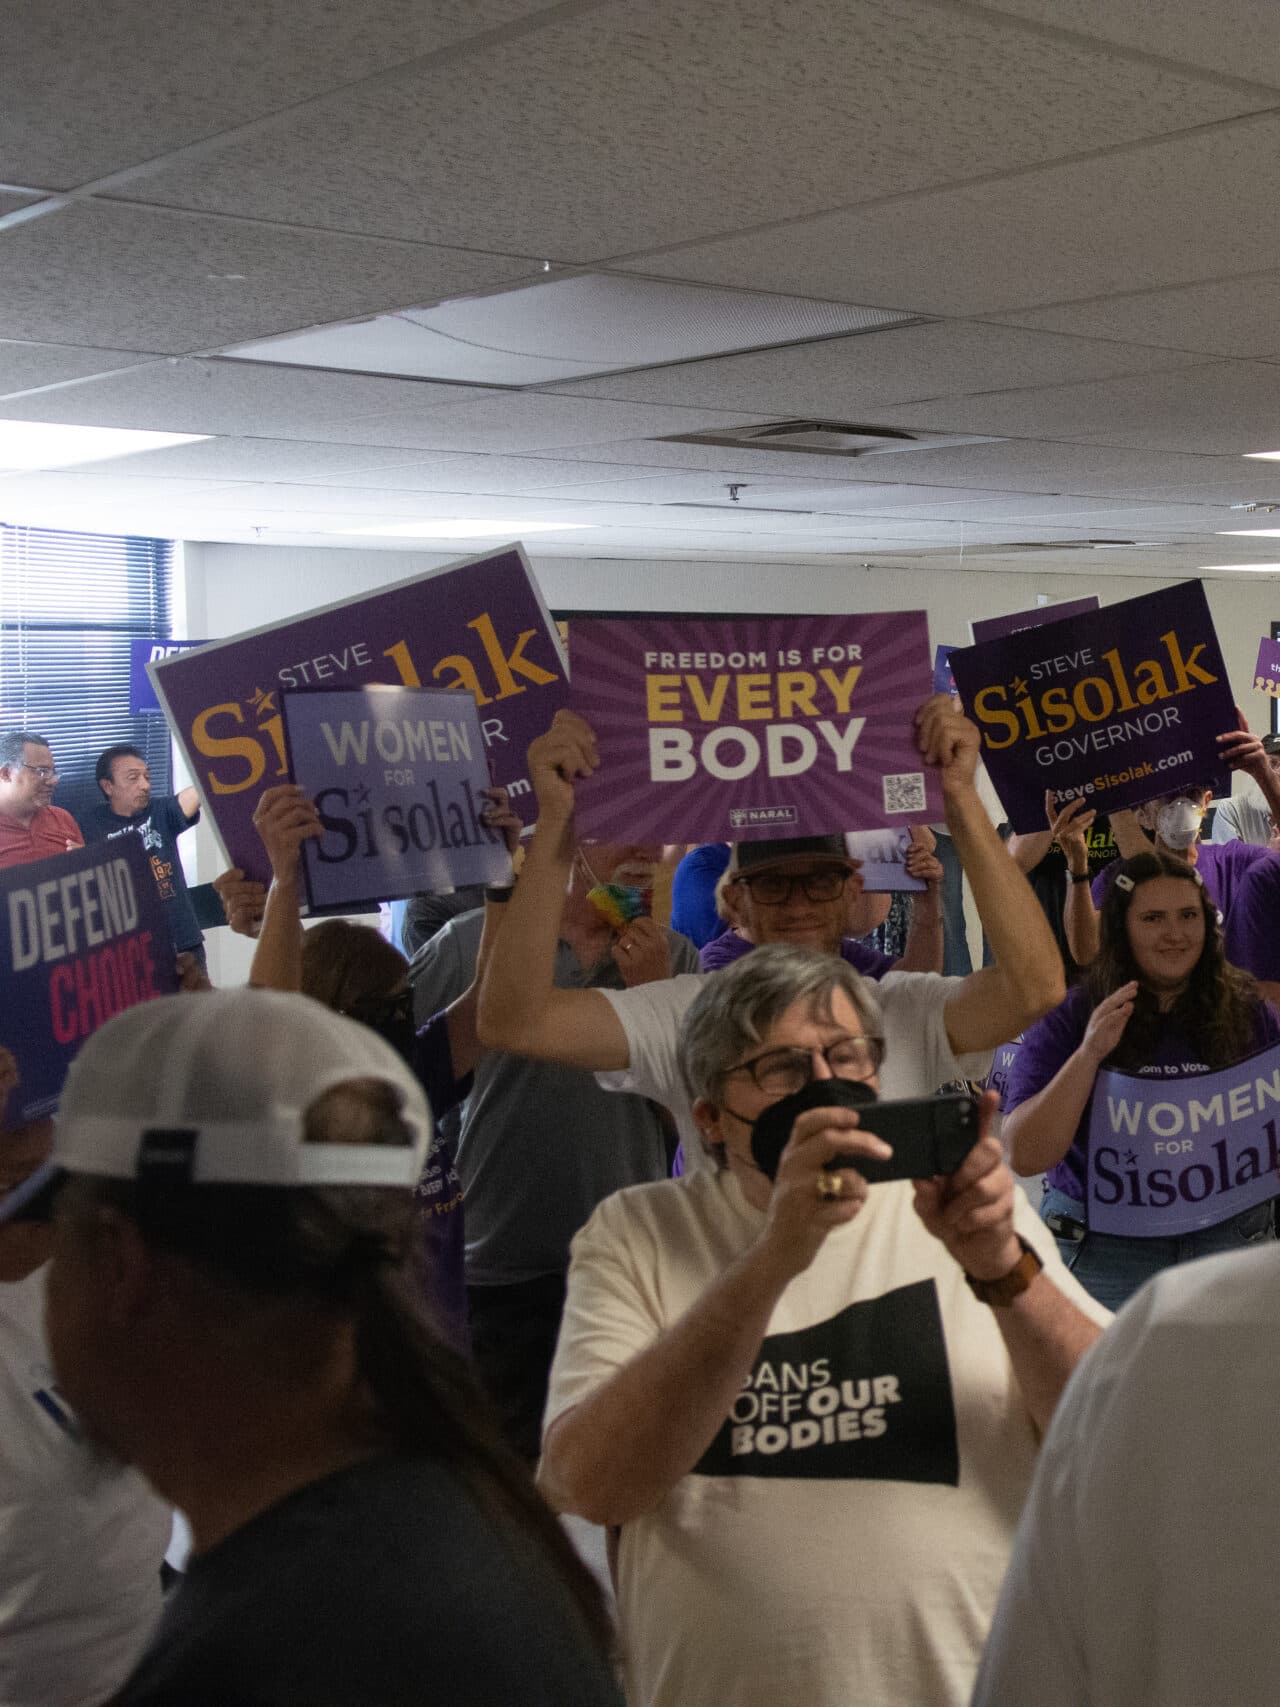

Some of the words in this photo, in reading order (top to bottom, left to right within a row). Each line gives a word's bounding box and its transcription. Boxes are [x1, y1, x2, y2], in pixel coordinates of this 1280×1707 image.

[279, 643, 373, 688] STEVE
[644, 651, 768, 670] FREEDOM
[778, 649, 802, 667] IS
[813, 644, 864, 665] FOR
[1030, 648, 1095, 681] STEVE
[192, 612, 559, 795] Silak
[645, 665, 864, 722] EVERY
[974, 630, 1218, 750] Sisolak
[320, 720, 473, 766] WOMEN
[648, 717, 867, 782] BODY
[1035, 707, 1182, 767] GOVERNOR
[384, 769, 416, 786] FOR
[750, 810, 792, 819] NARAL
[8, 858, 139, 972] DEFEND
[49, 931, 160, 1044] CHOICE
[1164, 1065, 1179, 1073] to
[1154, 1139, 1194, 1155] FOR
[730, 1392, 802, 1424] OFF
[807, 1375, 902, 1417] OUR
[731, 1407, 888, 1456] BODIES
